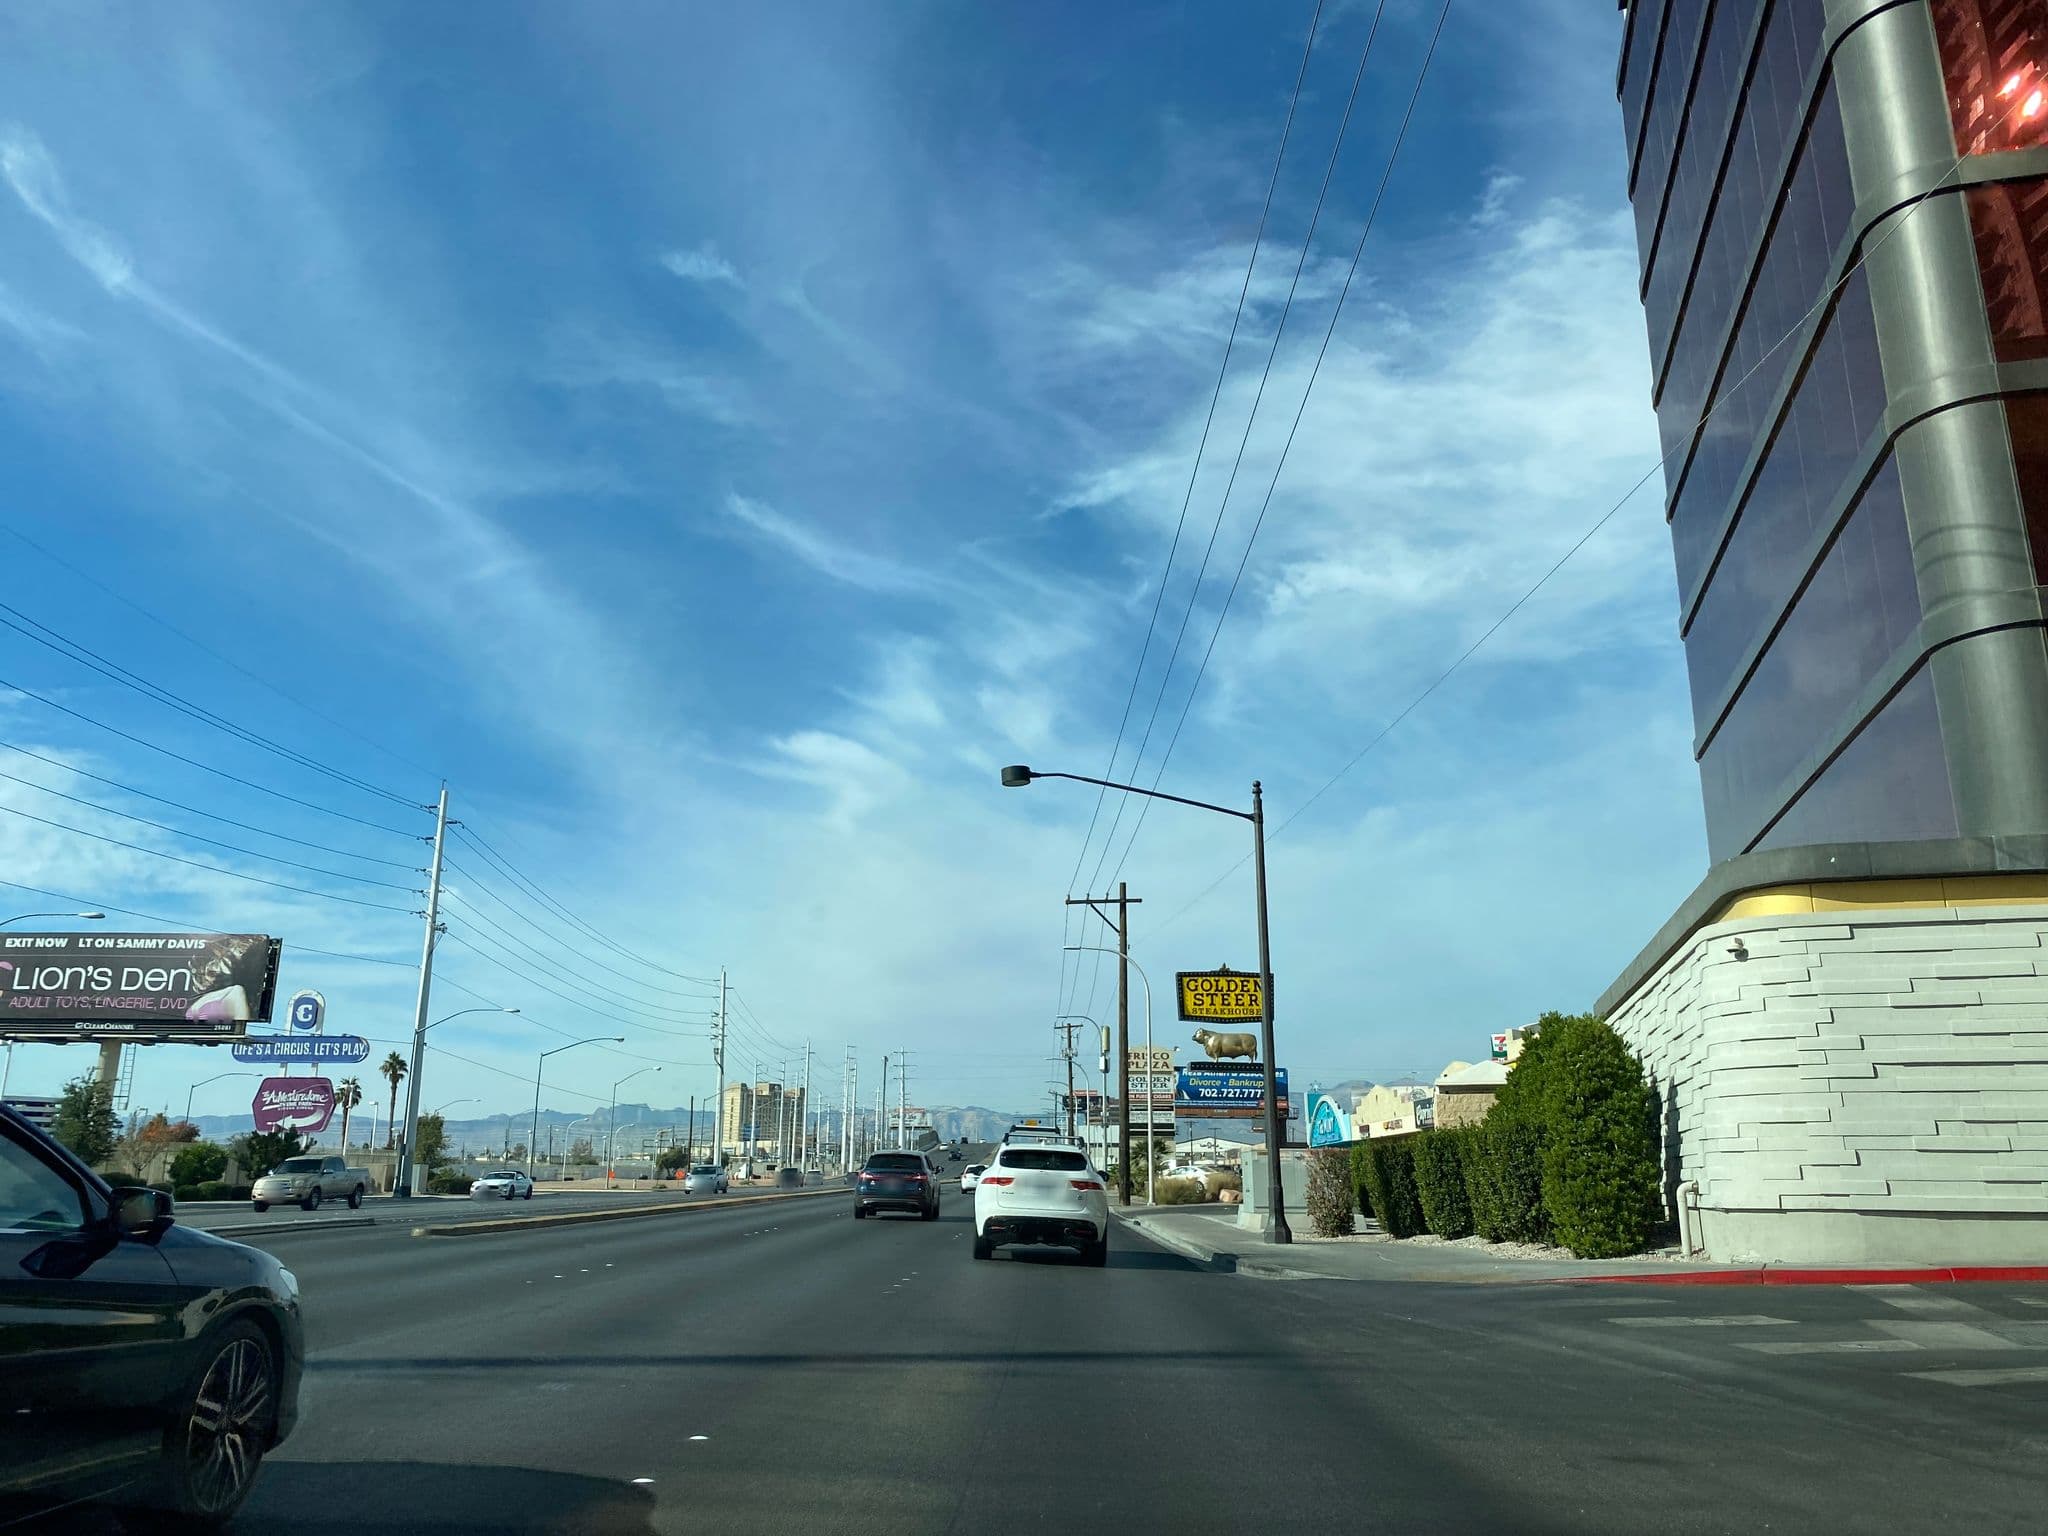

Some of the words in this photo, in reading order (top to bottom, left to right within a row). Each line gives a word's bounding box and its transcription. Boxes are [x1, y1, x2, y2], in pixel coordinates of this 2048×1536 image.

[5, 938, 33, 948] EXIT
[37, 938, 69, 948] NOW
[78, 938, 95, 949] LT
[95, 938, 115, 949] ON
[117, 938, 167, 949] SAMMY
[167, 939, 206, 949] DAVIS
[1186, 979, 1262, 992] GOLDEN
[9, 996, 51, 1008] ADULT
[56, 996, 92, 1009] TOYS,
[95, 997, 157, 1011] LINGERIE,
[160, 997, 187, 1010] DVD
[1193, 993, 1260, 1006] STEER
[1191, 1007, 1262, 1016] STEAKHOUSE
[234, 1043, 263, 1055] LIFE'S
[264, 1043, 271, 1055] A
[274, 1042, 312, 1055] CIRCUS.
[314, 1042, 341, 1055] LET'S
[1128, 1052, 1169, 1060] FRICO
[1189, 1078, 1221, 1086] Divorce
[1228, 1079, 1264, 1087] Bankrup
[1199, 1088, 1265, 1098] 702.727.777
